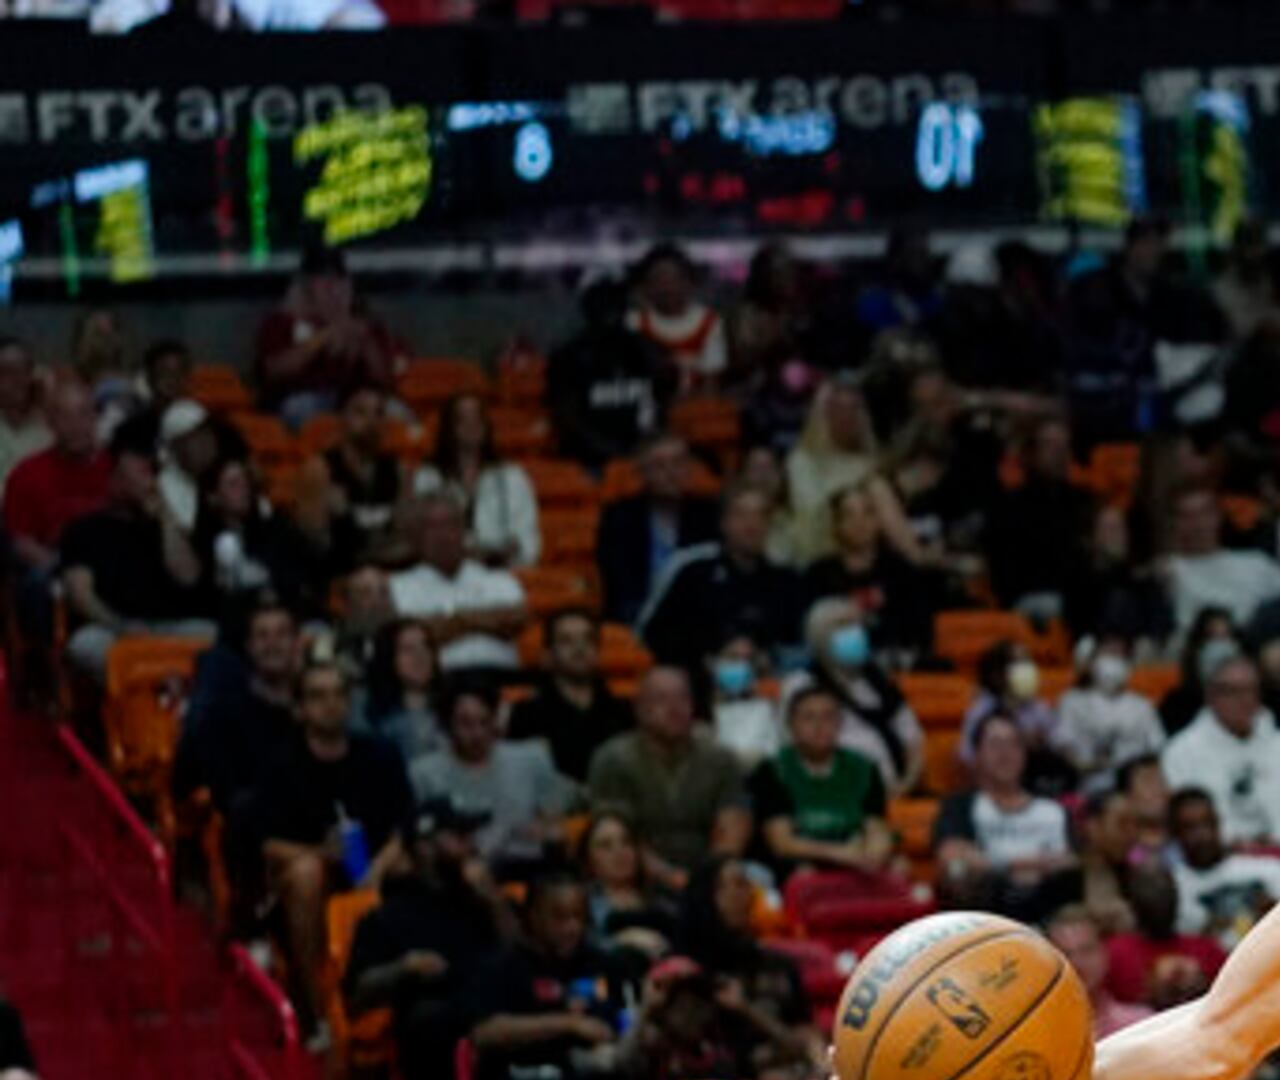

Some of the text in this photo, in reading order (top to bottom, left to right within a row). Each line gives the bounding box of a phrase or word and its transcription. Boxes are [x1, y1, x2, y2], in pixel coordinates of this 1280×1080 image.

[37, 88, 165, 144] FTX
[174, 80, 393, 140] arena
[769, 71, 981, 131] arena
